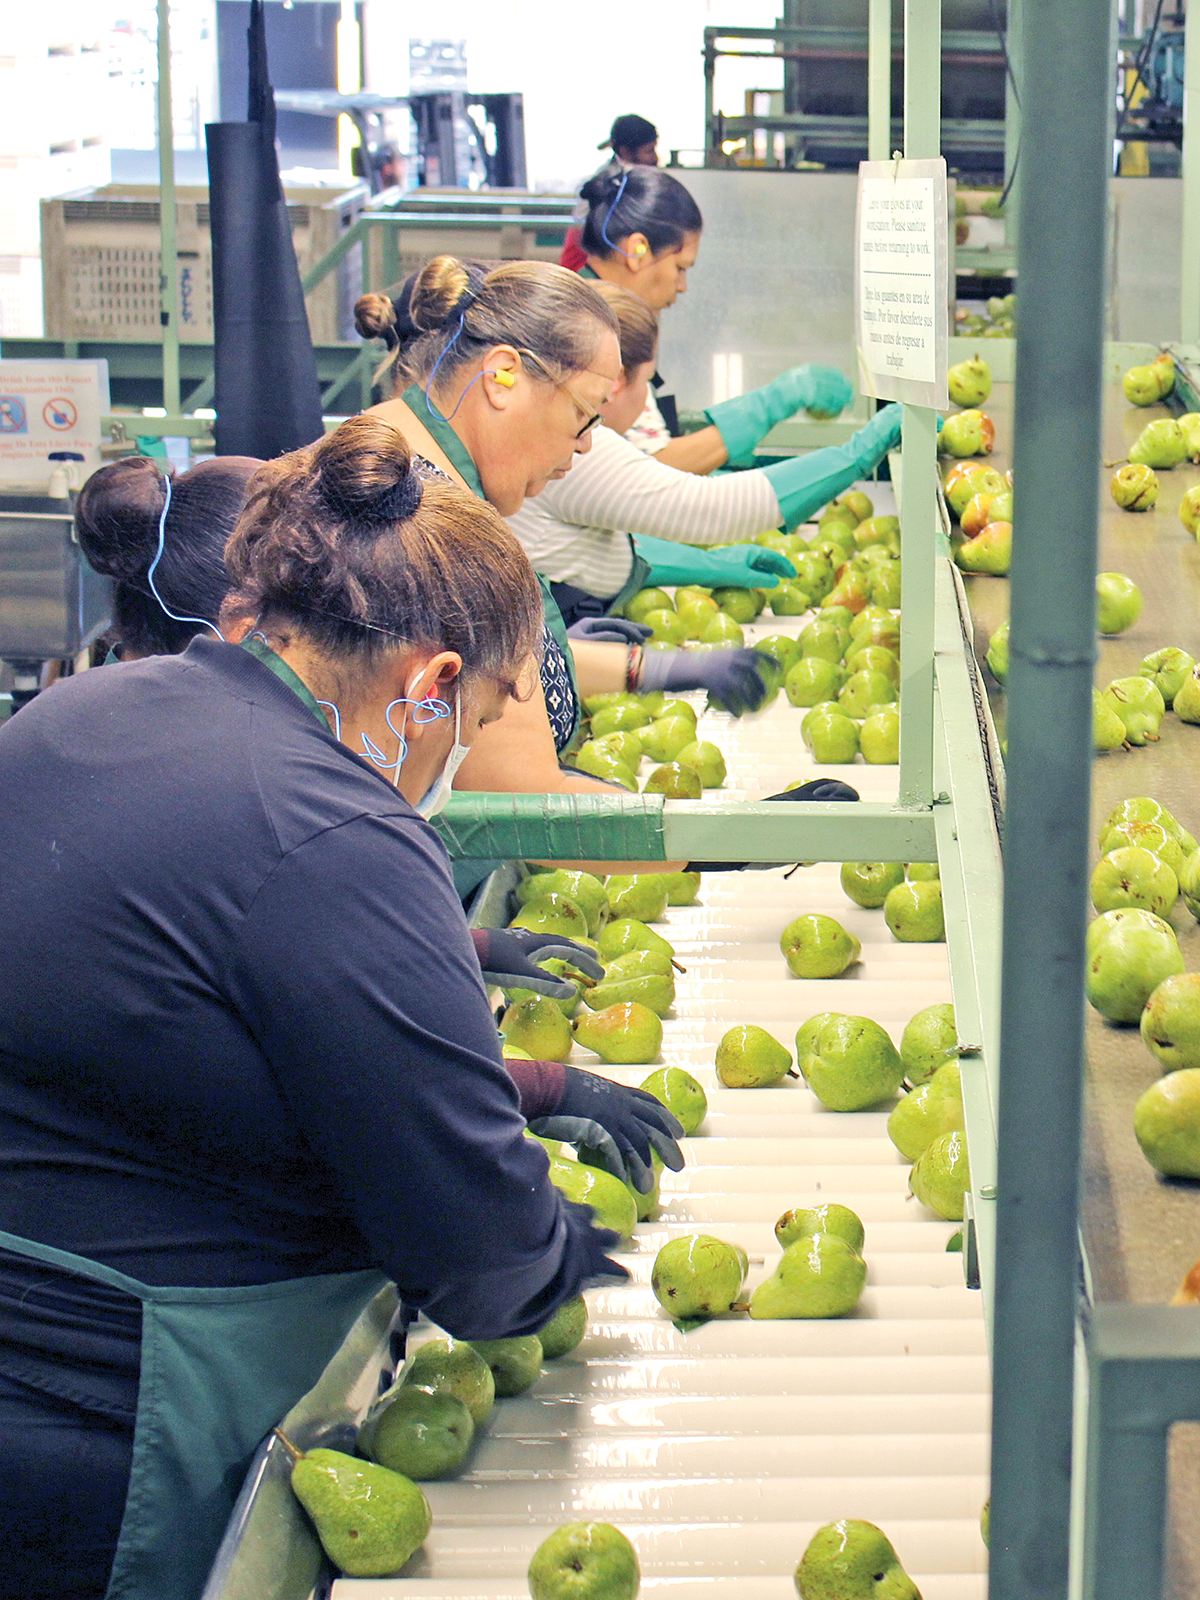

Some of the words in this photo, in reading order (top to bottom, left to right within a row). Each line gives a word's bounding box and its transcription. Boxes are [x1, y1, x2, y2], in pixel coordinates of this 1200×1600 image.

[892, 196, 905, 213] gloves
[912, 199, 925, 213] your
[892, 218, 907, 231] Please
[908, 218, 927, 232] sanitize
[889, 240, 910, 257] returning
[911, 241, 917, 253] to
[900, 292, 906, 303] en
[924, 289, 930, 304] de
[900, 309, 923, 325] desinfecte
[924, 315, 933, 327] sus
[896, 330, 902, 345] de
[902, 335, 921, 350] regresar
